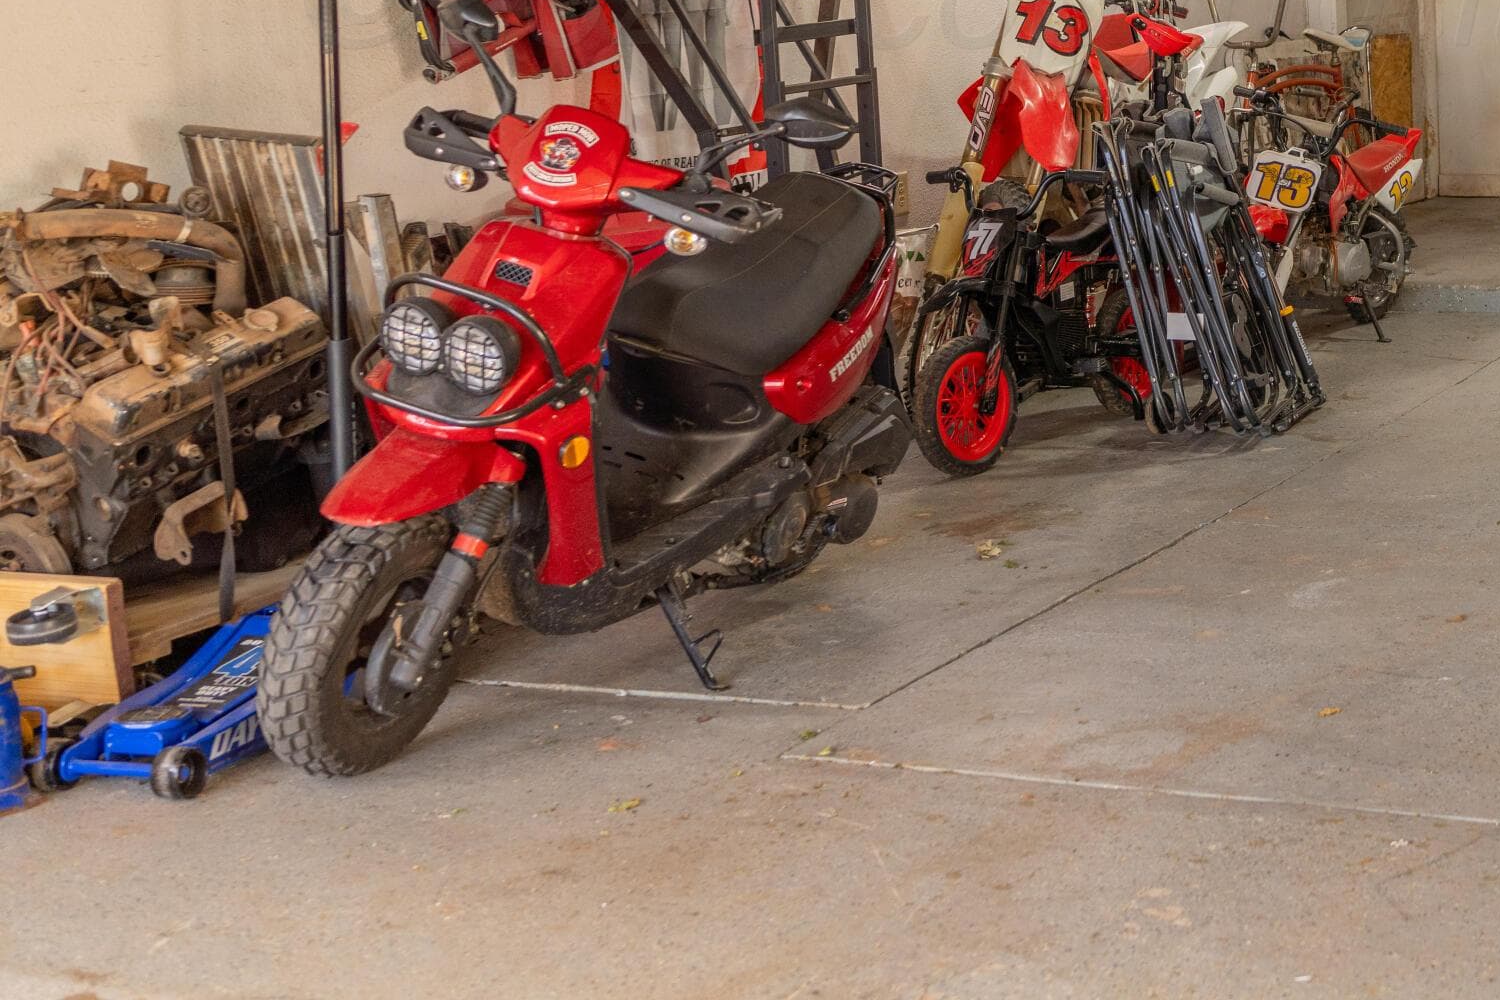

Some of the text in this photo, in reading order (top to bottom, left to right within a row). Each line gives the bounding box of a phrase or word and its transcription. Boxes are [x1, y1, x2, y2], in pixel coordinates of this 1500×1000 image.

[969, 86, 995, 151] EVO
[1255, 160, 1317, 209] 13
[1383, 152, 1405, 174] HONDA
[967, 222, 1004, 260] 77
[828, 324, 875, 383] FREEDOM
